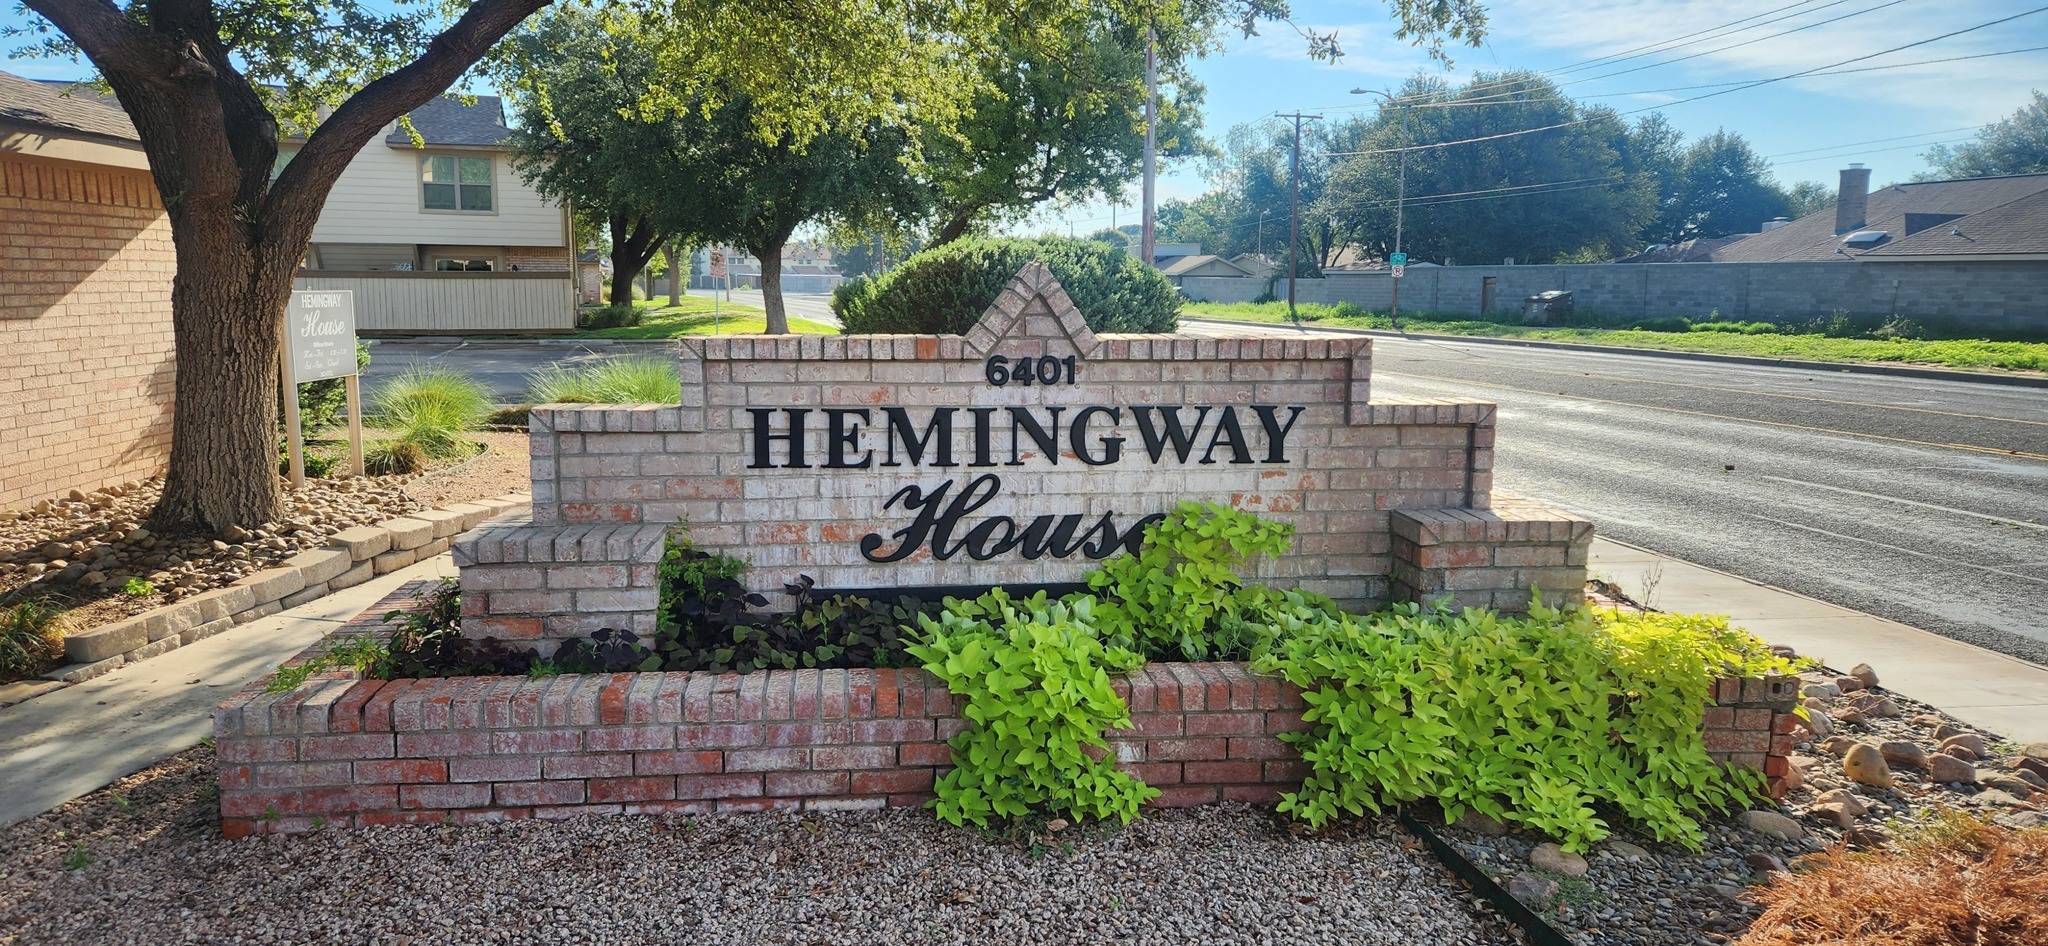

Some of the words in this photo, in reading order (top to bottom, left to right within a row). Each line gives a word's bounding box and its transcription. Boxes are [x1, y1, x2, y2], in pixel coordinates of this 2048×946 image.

[301, 293, 342, 308] HEMINGWAY
[300, 309, 346, 337] House
[985, 354, 1078, 387] 6401
[745, 405, 1307, 470] HEMINGWAY
